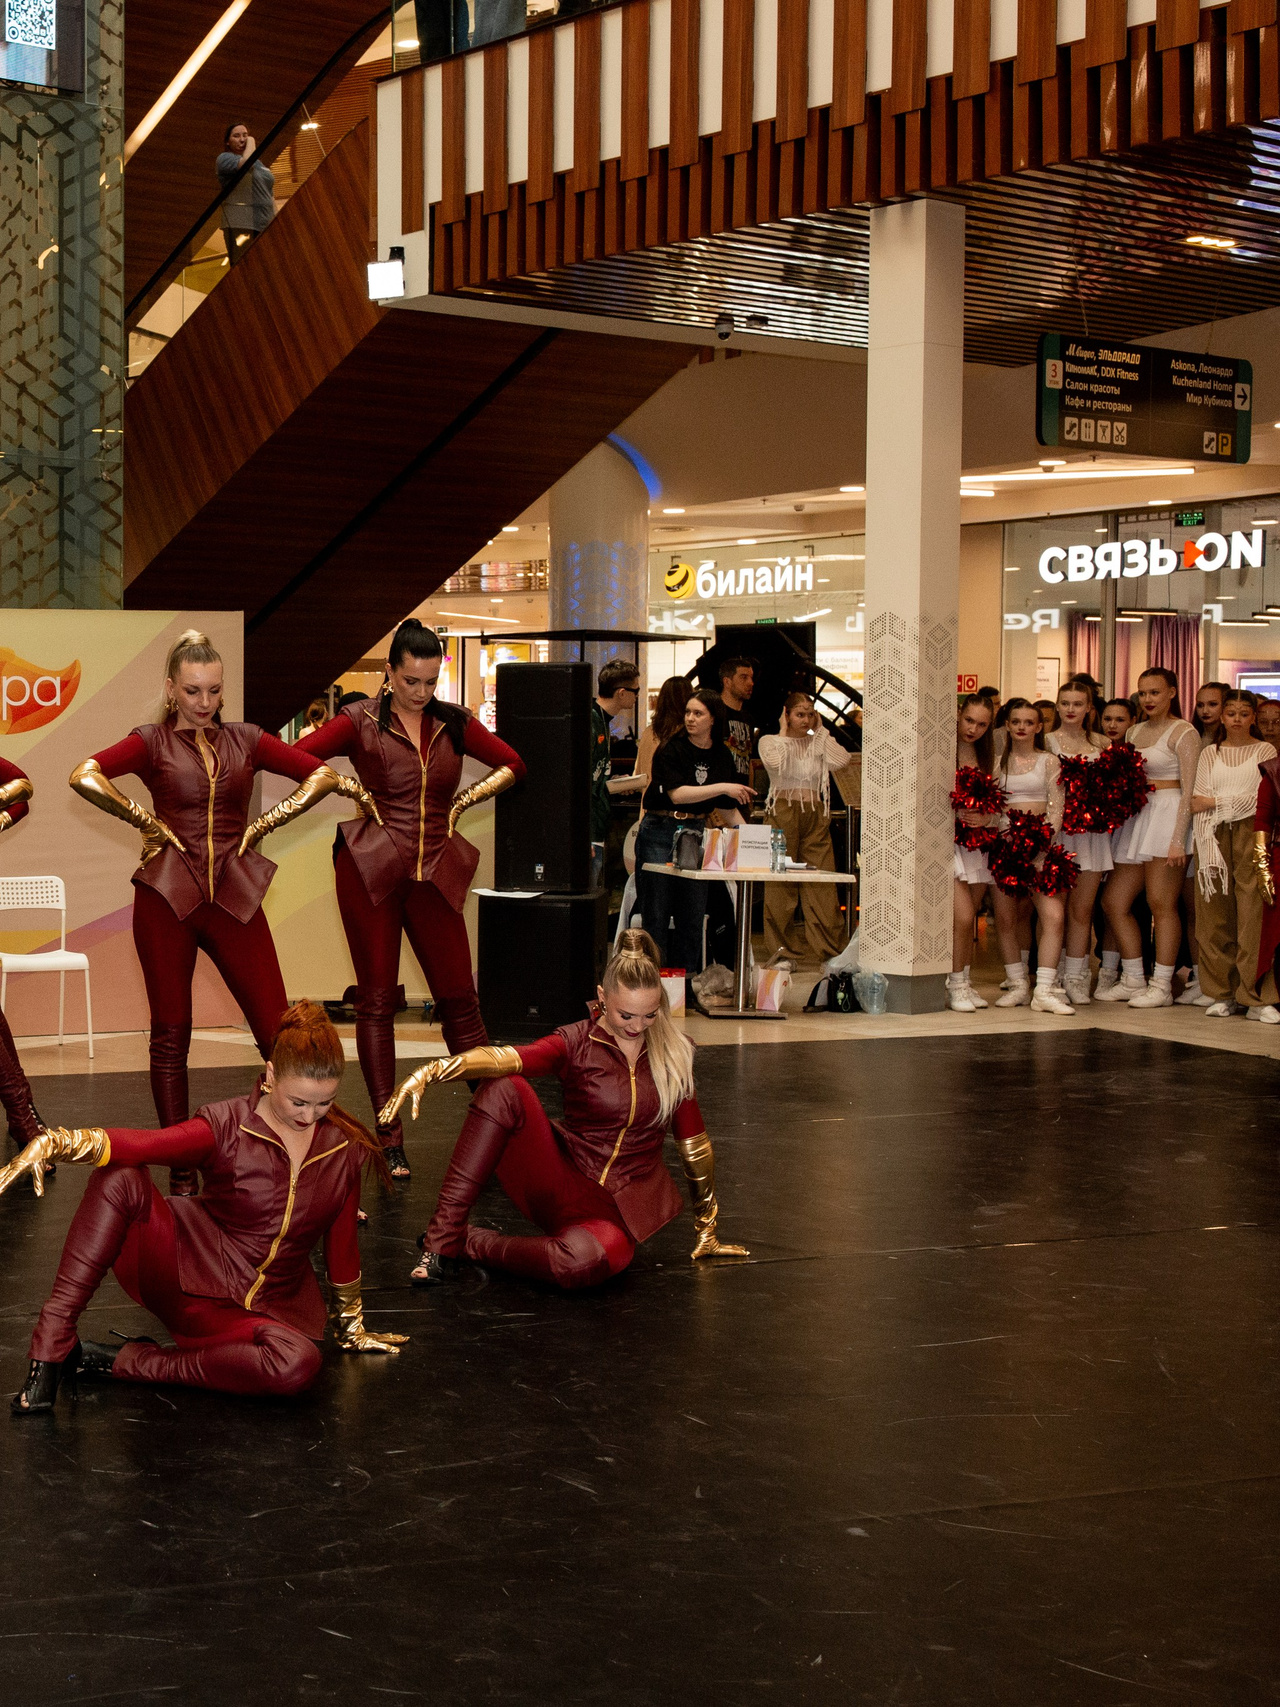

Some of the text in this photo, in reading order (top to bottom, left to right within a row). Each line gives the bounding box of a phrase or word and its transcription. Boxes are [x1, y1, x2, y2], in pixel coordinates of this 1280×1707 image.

[1098, 349, 1141, 365] ЭЛЬДОРАДО
[1050, 363, 1058, 378] 3
[1101, 366, 1116, 378] DDX
[1116, 368, 1139, 381] Fitness
[1170, 359, 1234, 378] Askona, Леонардо
[1065, 379, 1121, 395] Салон красоты
[1172, 375, 1233, 392] Kuchenland Home
[1065, 395, 1132, 412] Кафе и рестораны
[1186, 392, 1233, 408] Мир Кубиков
[1220, 436, 1229, 452] P
[1038, 529, 1266, 584] СВЯЗЬ ON
[696, 556, 814, 598] билайн
